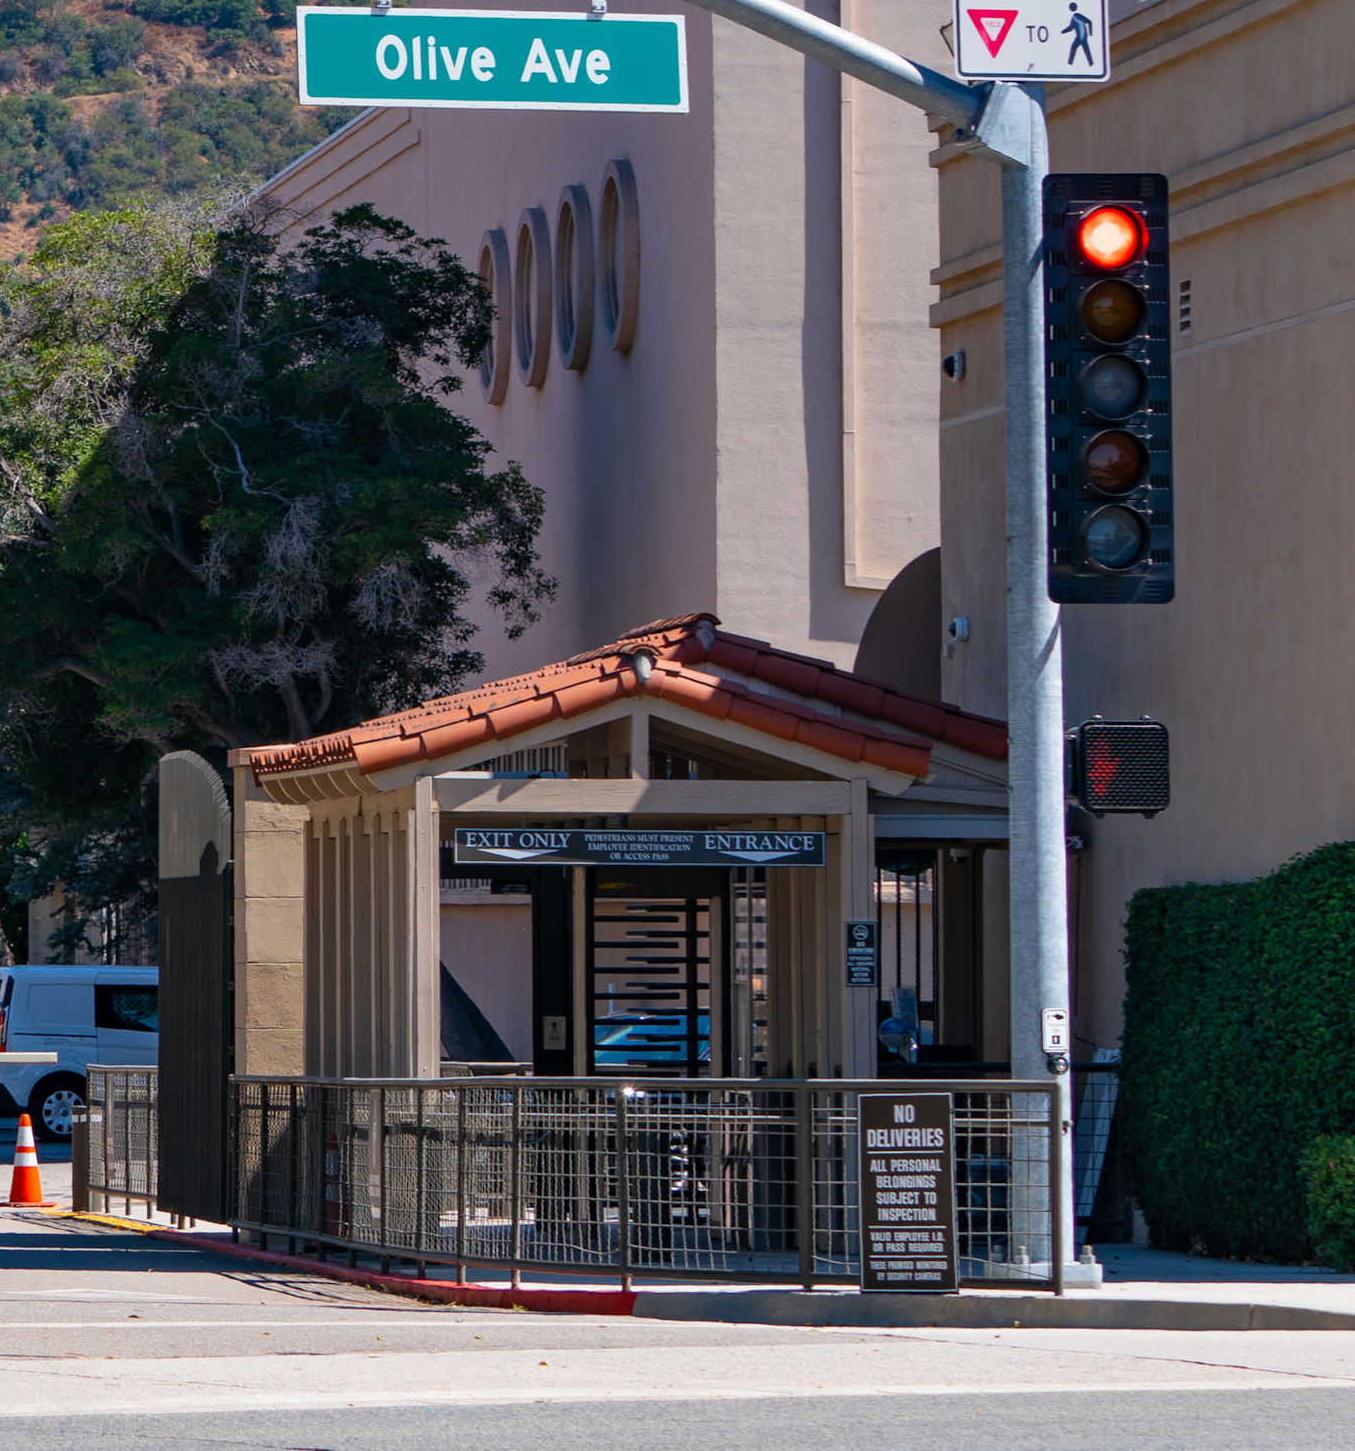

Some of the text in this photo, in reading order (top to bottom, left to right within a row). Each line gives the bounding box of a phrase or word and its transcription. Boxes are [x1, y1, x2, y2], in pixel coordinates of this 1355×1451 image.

[1025, 25, 1049, 43] TO
[375, 34, 611, 84] Olive Ave
[465, 832, 571, 848] EXIT ONLY
[584, 834, 694, 843] PEDESTRIANS MUST PRESENT
[704, 835, 815, 851] ENTRANCE
[588, 843, 691, 851] EMPLOYEE IDENTIFICATION
[609, 852, 670, 861] OR ACCESS PASS
[894, 1104, 915, 1123] NO
[866, 1128, 944, 1148] DELIVERIES
[870, 1159, 942, 1172] ALL PERSONAL
[876, 1175, 936, 1188] BELONGINGS
[876, 1191, 937, 1205] SUBJECT TO
[878, 1208, 937, 1221] INSPECTION
[870, 1231, 891, 1241] VALID
[894, 1231, 930, 1241] EMPLOYEE
[872, 1242, 884, 1252] OR
[885, 1242, 906, 1252] PASS
